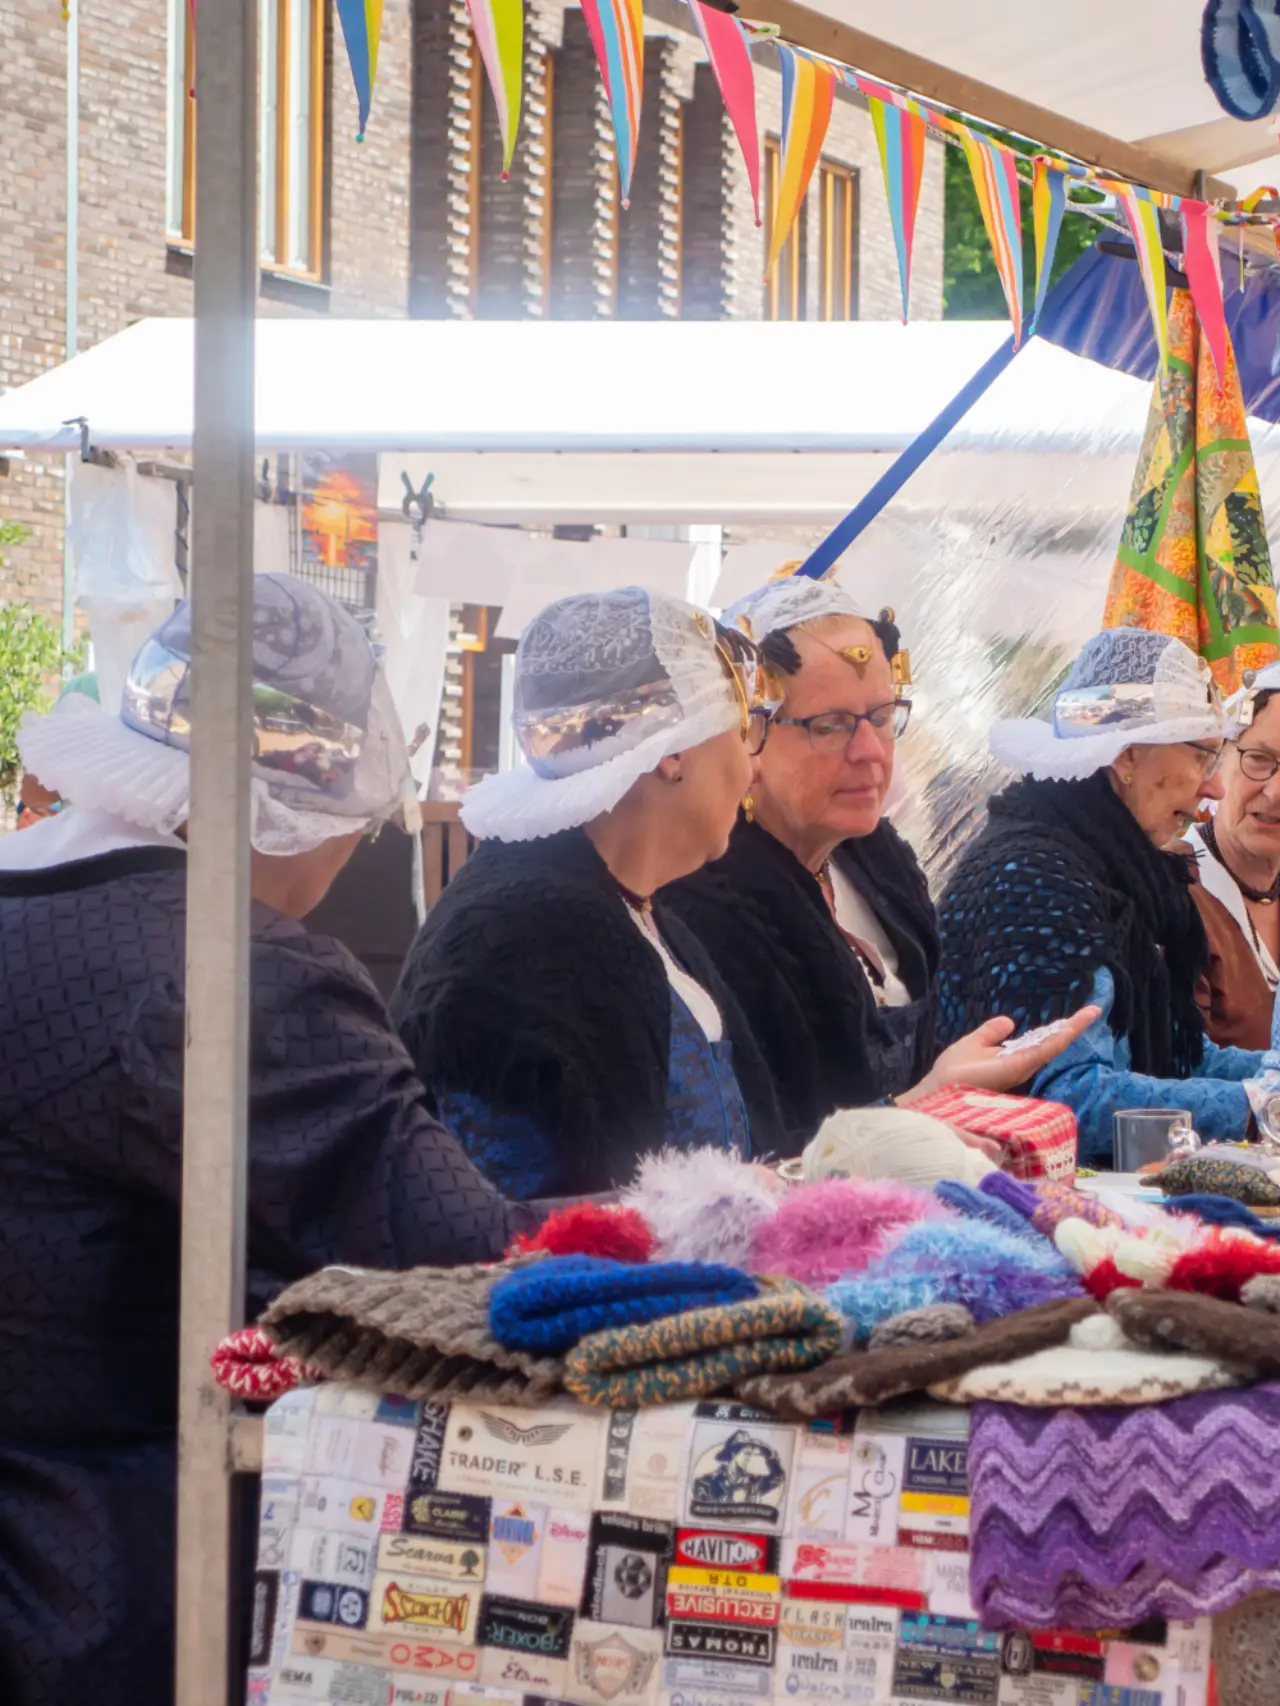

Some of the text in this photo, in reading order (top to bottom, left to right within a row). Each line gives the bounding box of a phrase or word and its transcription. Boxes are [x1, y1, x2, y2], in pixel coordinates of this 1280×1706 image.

[448, 1452, 521, 1476] TRADER
[535, 1465, 587, 1488] L.S.E.
[673, 1594, 777, 1620] EXCLUSIVE
[672, 1636, 768, 1657] THOMAS
[279, 1668, 314, 1685] HEMA
